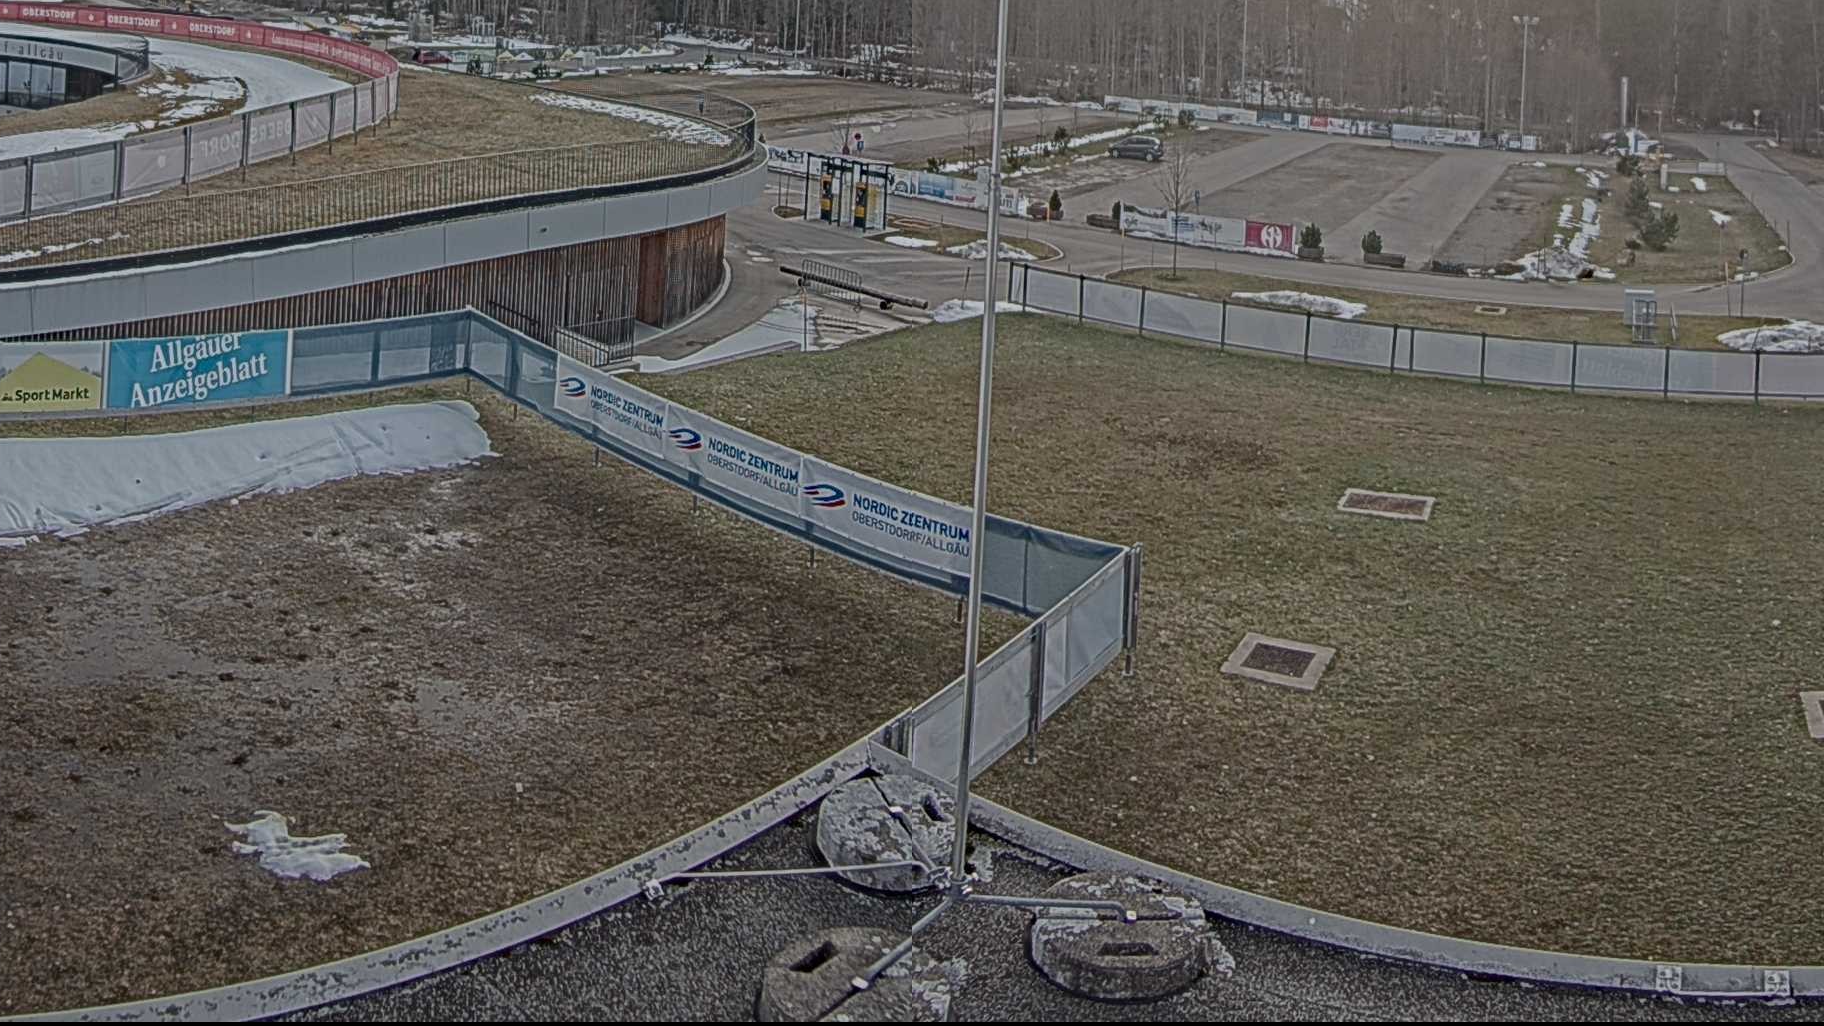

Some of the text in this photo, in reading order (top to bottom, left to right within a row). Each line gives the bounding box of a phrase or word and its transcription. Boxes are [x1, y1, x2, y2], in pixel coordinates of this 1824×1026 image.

[149, 333, 243, 373] Allgäuer
[130, 353, 268, 409] Anzeigeblatt
[590, 385, 664, 428] NORDIC ZENTRUM
[708, 437, 800, 484] NORDIC ZENTRUM
[853, 493, 898, 521] NORDIC
